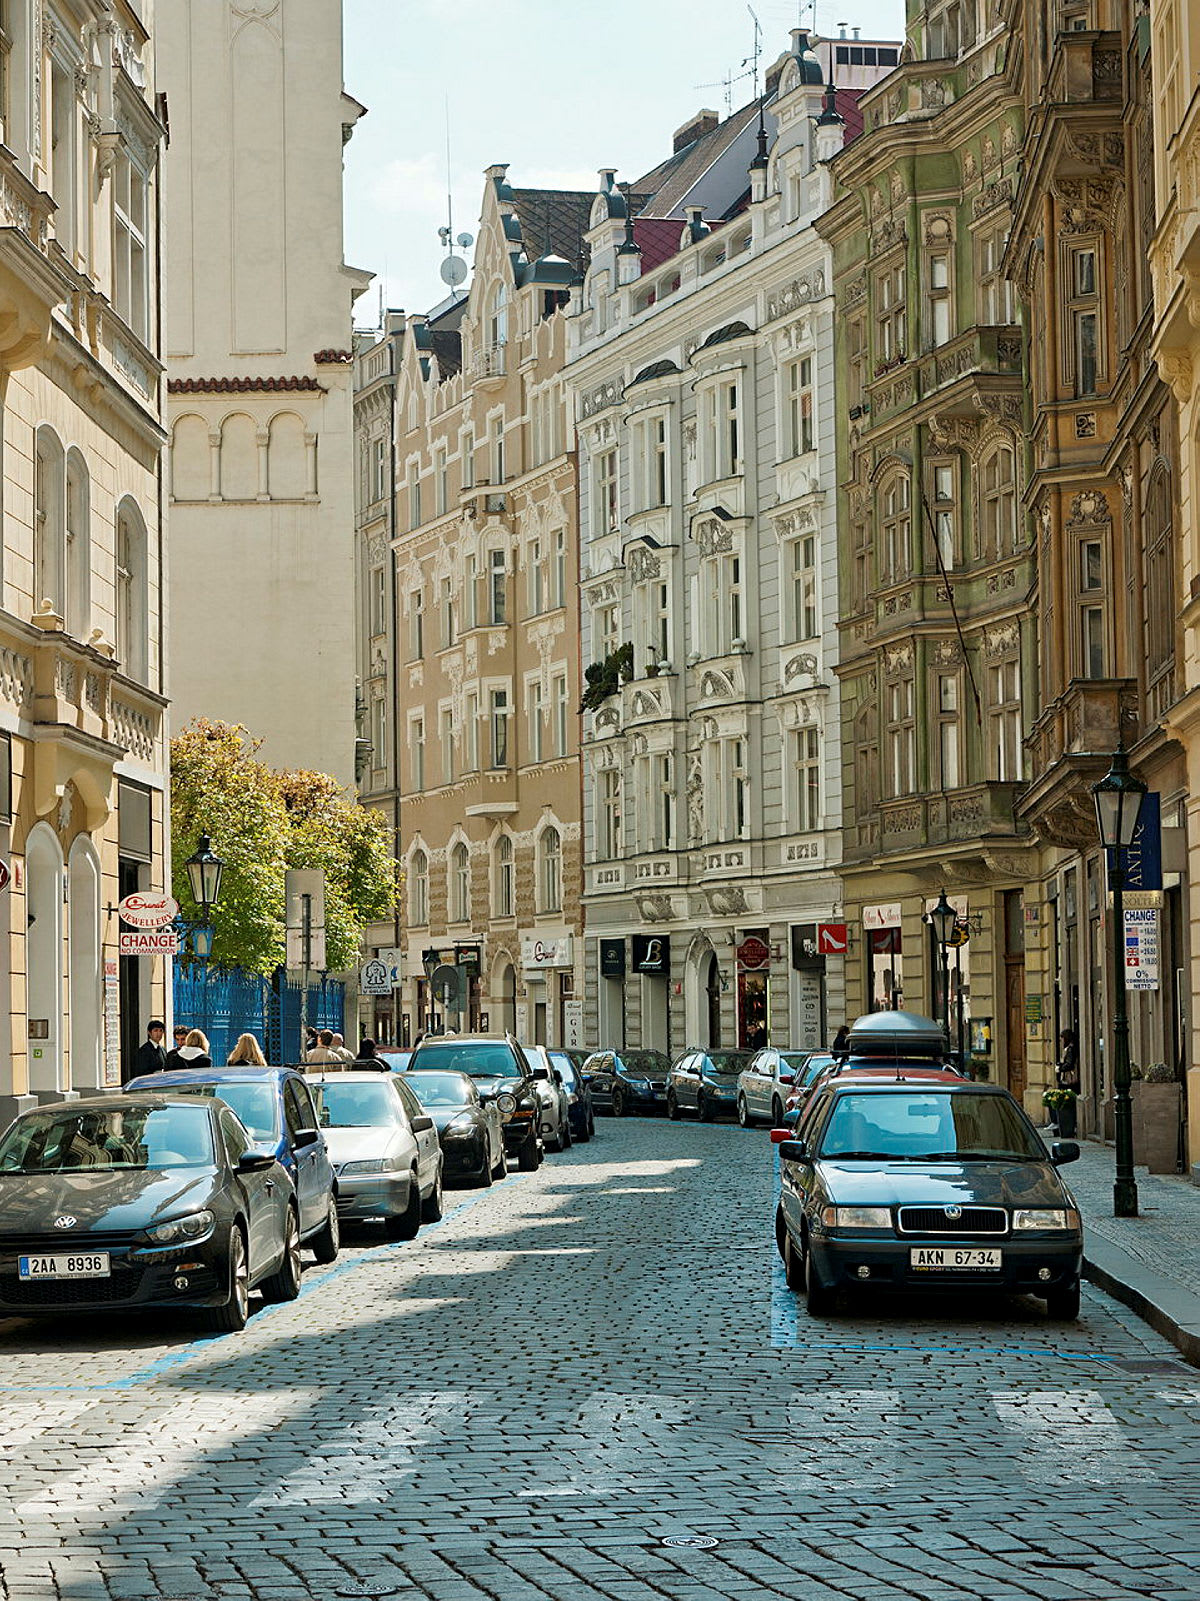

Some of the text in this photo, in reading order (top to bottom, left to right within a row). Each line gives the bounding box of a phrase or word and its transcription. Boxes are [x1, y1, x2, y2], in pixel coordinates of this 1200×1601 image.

[122, 912, 172, 926] JEWELLERY
[1124, 910, 1156, 921] CHANGE
[121, 935, 175, 947] CHANGE
[31, 1256, 102, 1273] 2AA 8936
[918, 1250, 995, 1265] AKN 67-34
